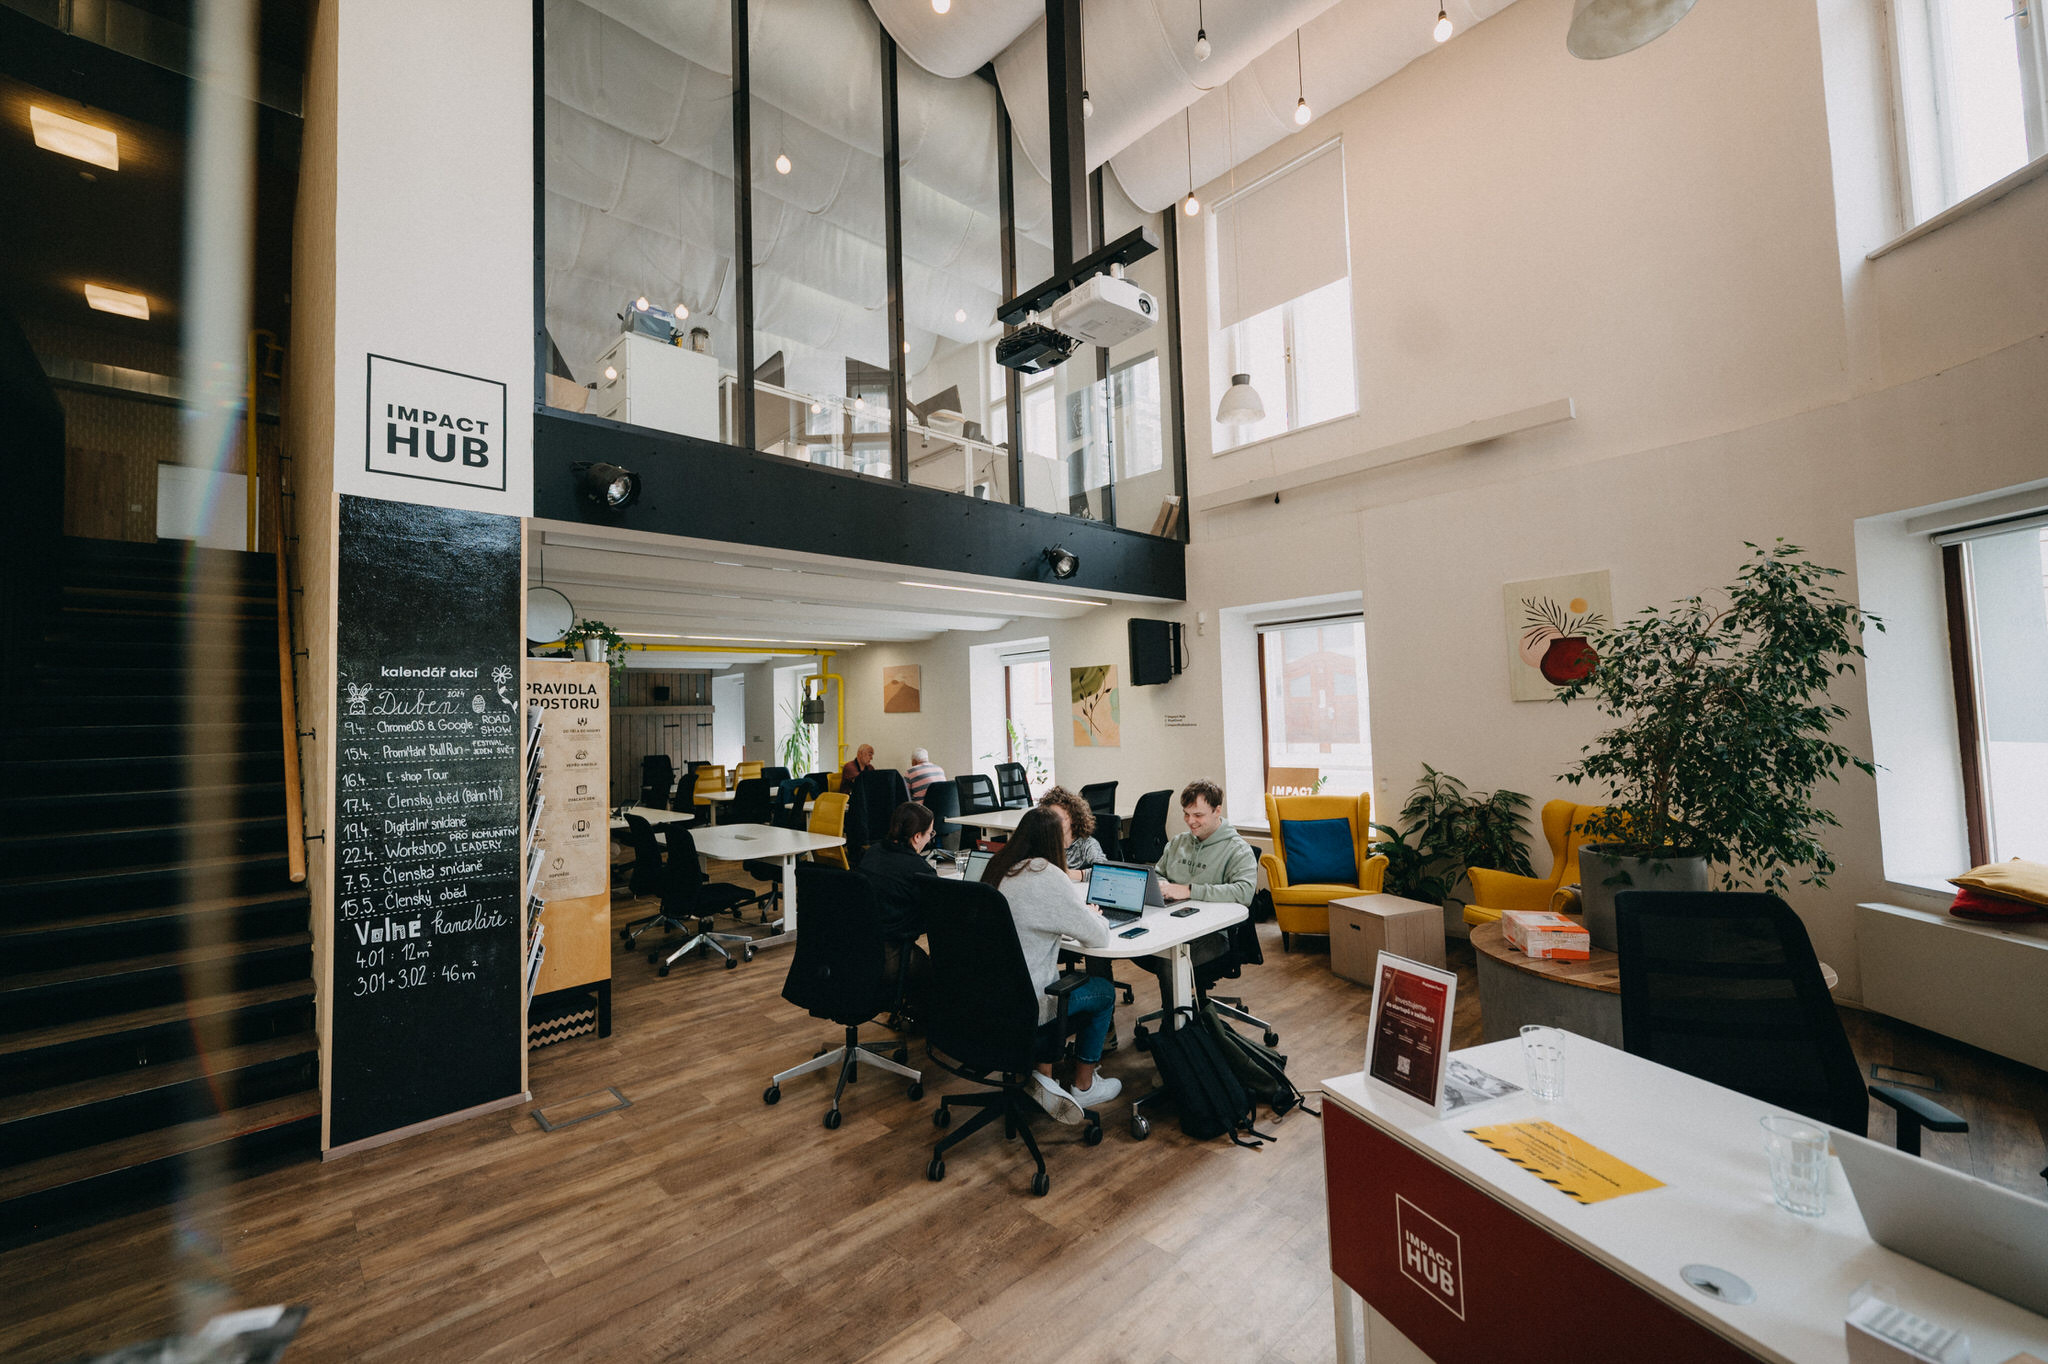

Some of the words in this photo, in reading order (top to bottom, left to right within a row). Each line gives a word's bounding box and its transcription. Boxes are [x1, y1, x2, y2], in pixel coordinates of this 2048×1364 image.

[387, 403, 489, 435] IMPACT
[387, 422, 489, 468] HUB
[381, 666, 446, 678] kalendář
[450, 667, 478, 678] akcí
[526, 683, 597, 695] PRAVIDLA
[372, 690, 460, 715] Duben
[526, 698, 600, 710] ROSTORU
[377, 720, 426, 733] ChromeOS
[427, 721, 437, 732] &
[438, 718, 474, 734] Google
[481, 714, 511, 724] ROAD
[481, 725, 512, 735] SHOW
[423, 768, 449, 780] Tour
[387, 792, 433, 809] Členský
[435, 791, 460, 804] oběd
[431, 814, 468, 830] snídaně
[449, 832, 468, 842] PRO
[471, 825, 519, 840] KOMUNITNÍ
[384, 840, 447, 859] Workshop
[454, 839, 503, 854] LEADERY
[383, 864, 435, 885] Členská
[439, 858, 484, 877] snídaně
[384, 890, 433, 910] Členský
[439, 883, 468, 900] oběd
[354, 913, 422, 946] Volné
[1405, 1229, 1453, 1271] IMPACT
[1406, 1241, 1455, 1297] HUB
